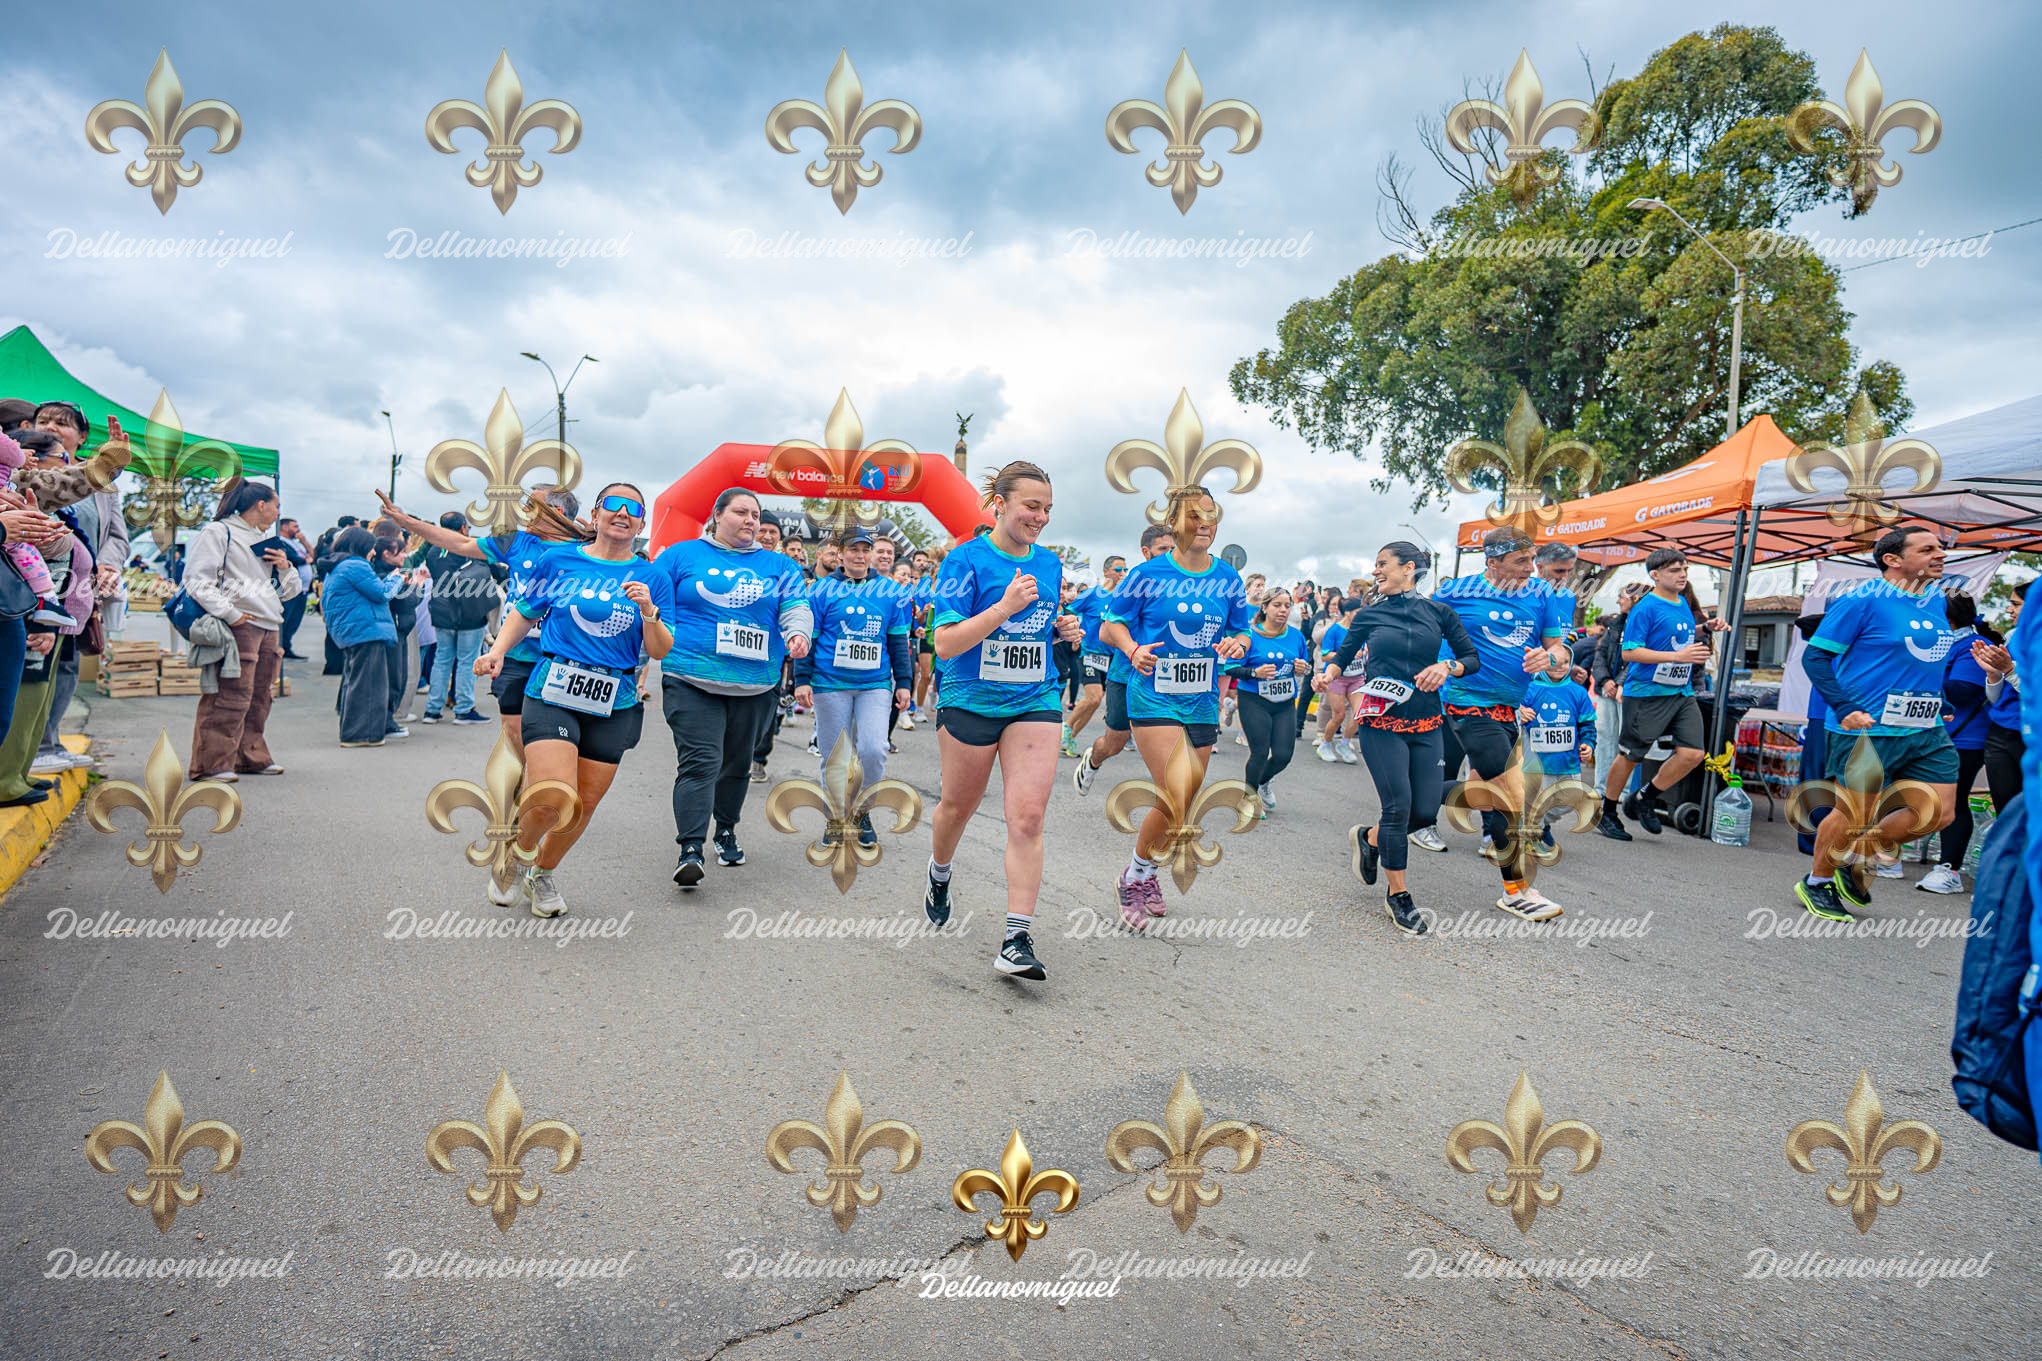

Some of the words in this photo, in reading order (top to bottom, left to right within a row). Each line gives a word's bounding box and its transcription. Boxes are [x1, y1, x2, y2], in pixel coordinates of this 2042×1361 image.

[772, 470, 796, 480] new
[797, 469, 845, 484] balance
[1650, 496, 1714, 518] GATORADE
[1557, 517, 1607, 534] GATORADE
[733, 628, 764, 651] 16617
[849, 643, 878, 661] 16616
[1002, 645, 1042, 670] 16614
[1173, 662, 1208, 683] 16611
[566, 673, 613, 704] 15489
[1268, 681, 1292, 696] 15682
[1370, 680, 1406, 697] 15729
[1904, 700, 1940, 719] 16588
[1544, 729, 1572, 745] 16518
